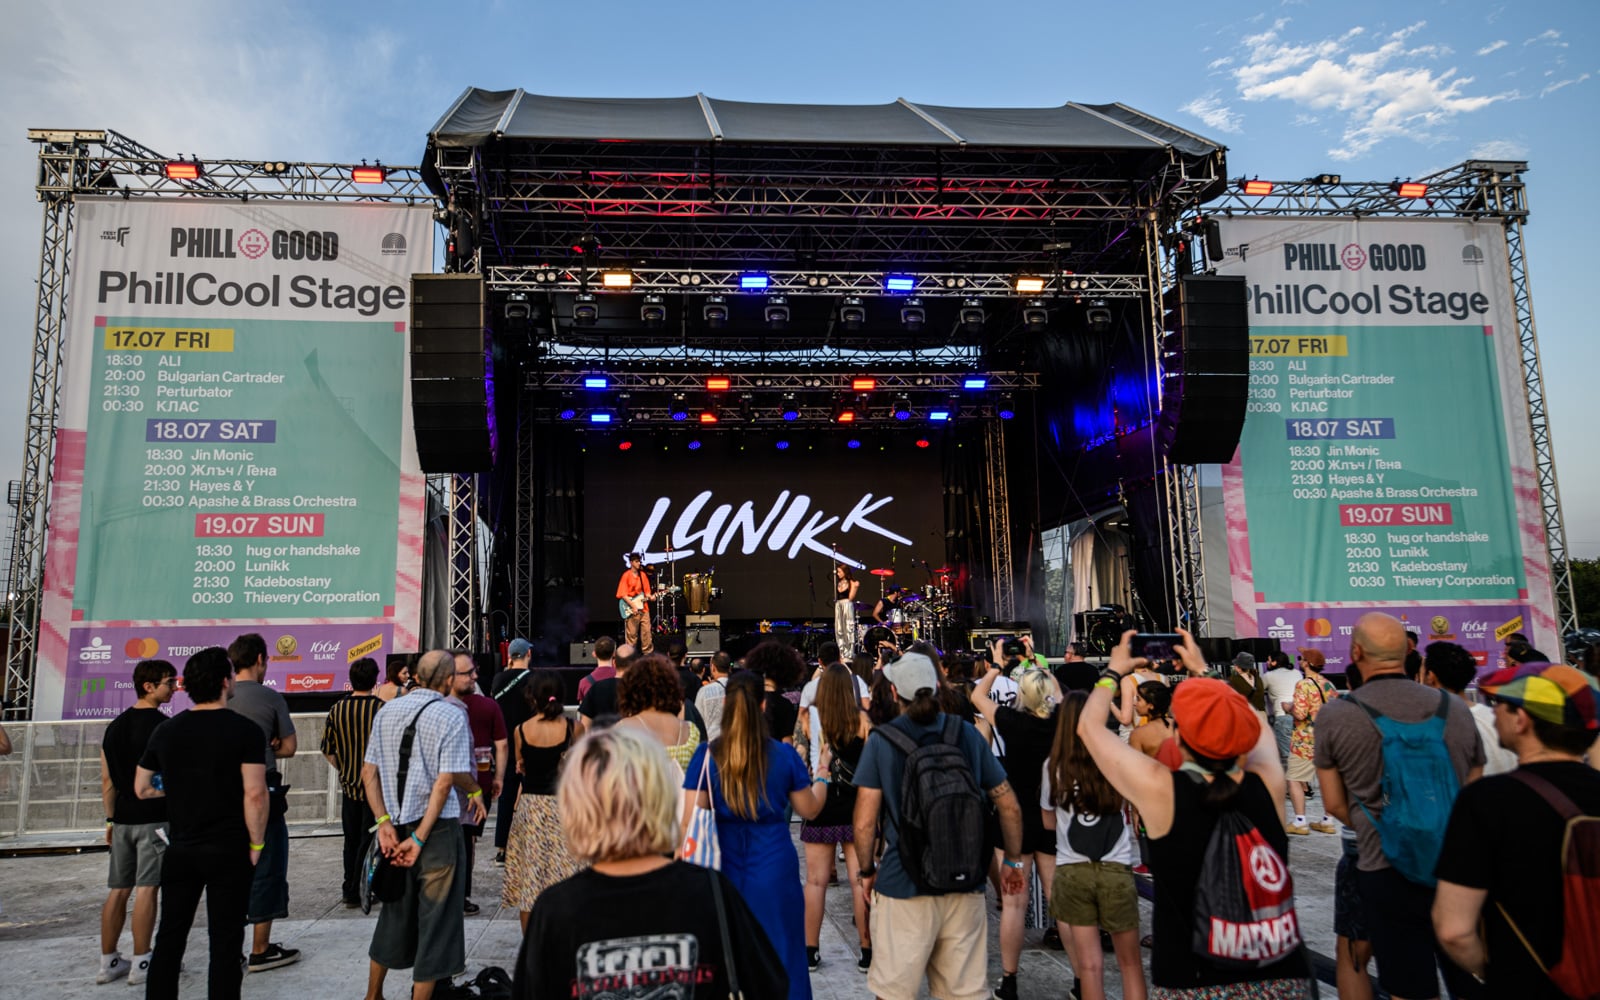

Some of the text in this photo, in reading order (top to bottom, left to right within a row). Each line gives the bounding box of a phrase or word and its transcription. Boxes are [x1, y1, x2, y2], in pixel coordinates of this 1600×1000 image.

[170, 227, 339, 261] PHILL GOOD
[1284, 242, 1426, 272] PHILL GOOD
[98, 270, 406, 316] PhillCool Stage
[1388, 284, 1490, 320] Stage
[112, 330, 210, 349] 17.07 FRI
[1298, 338, 1328, 354] FRI
[105, 354, 182, 368] 18:30 ALI
[1249, 360, 1307, 372] 8:30 ALI
[104, 370, 285, 386] 20:00 Bulgarian Cartrader
[1288, 374, 1341, 388] Bulgarian
[1341, 374, 1396, 385] Cartrader
[103, 385, 234, 398] 21:30 Perturbator
[1290, 388, 1354, 399] Perturbator
[102, 400, 200, 413] 00:30 КЛАС
[1247, 402, 1329, 413] 00:30 КЛАС
[154, 422, 263, 440] 18.07 SAT
[1292, 420, 1383, 437] 18.07 SAT
[145, 449, 254, 462] 18:30 Jin Monic
[1289, 445, 1380, 457] 18:30 Jin Monic
[144, 464, 186, 476] 20:00
[190, 464, 234, 477] Жлъч
[246, 465, 277, 477] Гена
[1290, 460, 1325, 471] 20:00
[143, 480, 255, 495] 21:30 Hayes & Y
[1292, 473, 1384, 488] 21:30 Hayes & Y
[1292, 486, 1478, 501] 00:30 Apashe & Brass Orchestra
[142, 495, 358, 511] 00:30 Apashe & Brass Orchestra
[1346, 506, 1444, 524] 19.07 SUN
[203, 516, 315, 534] 19.07 SUN
[622, 490, 913, 570] LUNIKK
[1344, 532, 1489, 546] 18:30 hug or handshake
[196, 544, 361, 560] 18:30 hug or handshake
[1346, 546, 1429, 558] 20:00 Lunikk
[194, 560, 290, 572] 20:00 Lunikk
[1347, 560, 1468, 574] 21:30 Kadebostany
[193, 575, 332, 591] 21:30 Kadebostany
[1349, 574, 1516, 589] 00:30 Thievery Corporation
[192, 590, 380, 606] 00:30 Thievery Corporation
[1460, 620, 1488, 632] 1664
[310, 640, 342, 654] 1664
[314, 653, 336, 661] BLANC
[1211, 913, 1300, 960] MARVEL
